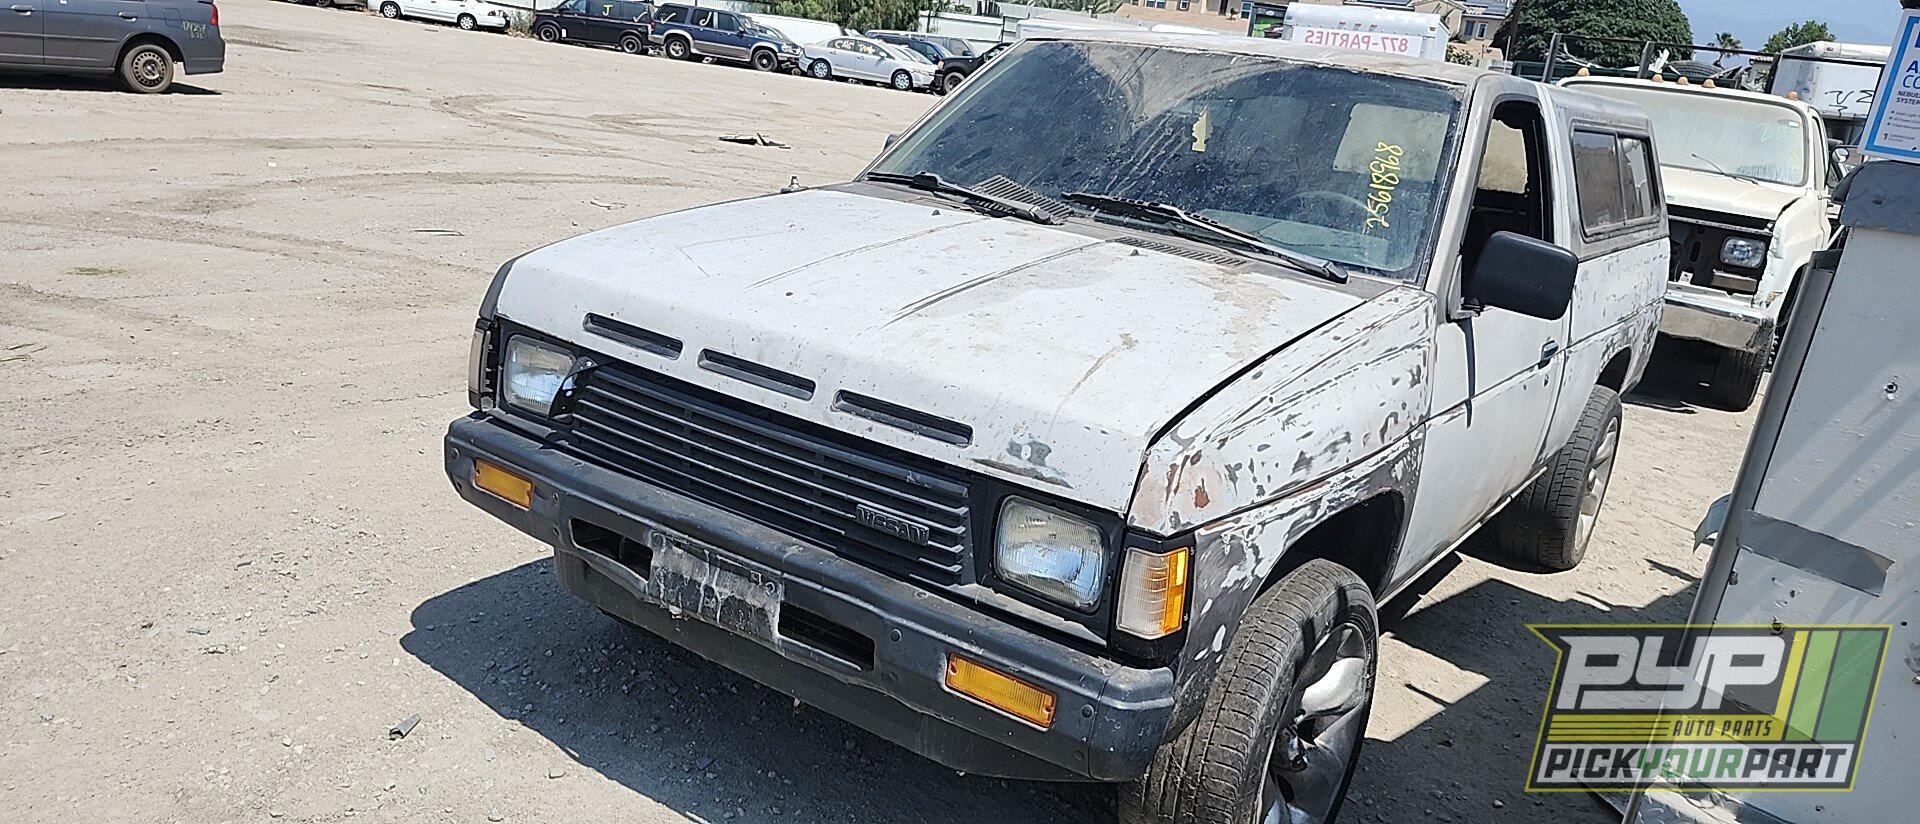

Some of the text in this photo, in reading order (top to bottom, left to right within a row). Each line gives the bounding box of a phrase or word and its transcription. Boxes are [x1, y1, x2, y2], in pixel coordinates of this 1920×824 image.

[1905, 60, 1920, 74] A
[1366, 141, 1403, 228] 25618968
[856, 506, 929, 546] NISSAN
